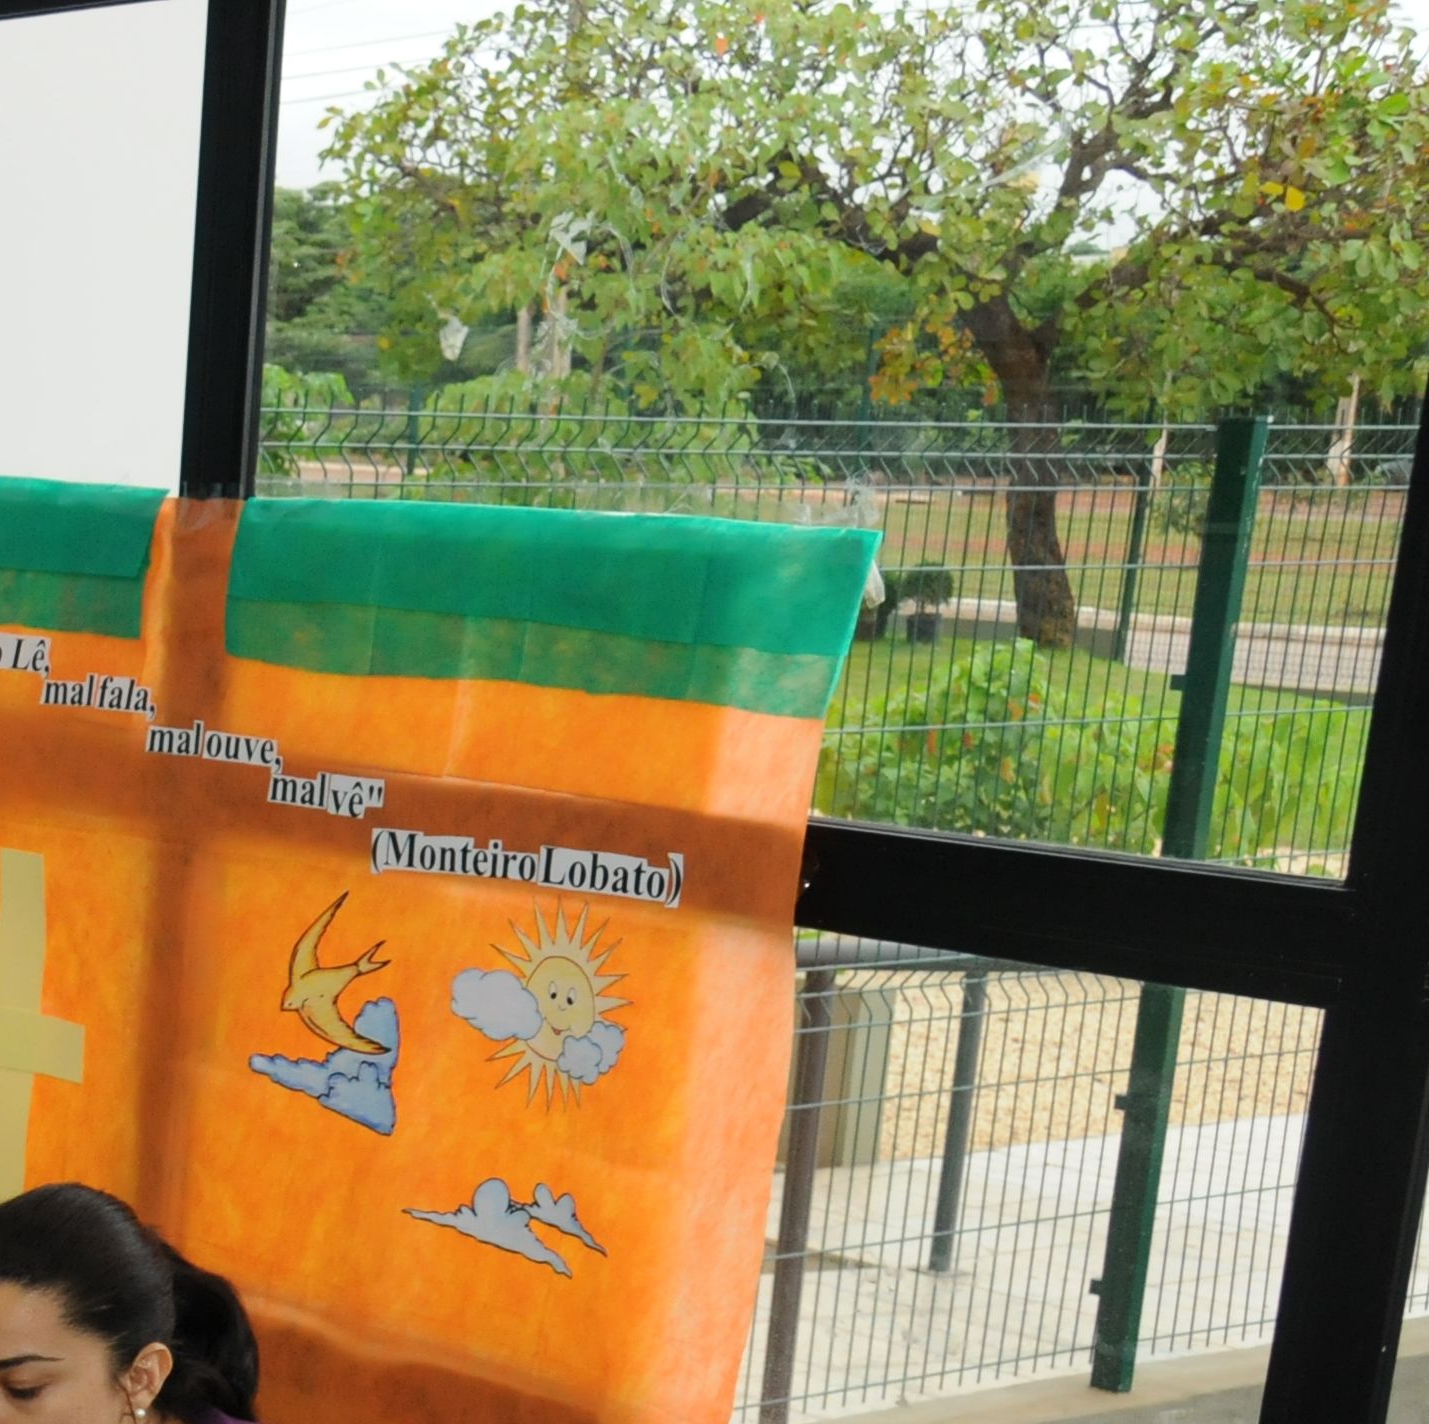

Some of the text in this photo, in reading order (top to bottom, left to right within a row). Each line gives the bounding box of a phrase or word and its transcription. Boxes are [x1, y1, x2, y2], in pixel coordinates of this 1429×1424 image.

[11, 638, 50, 677] Lê,
[43, 674, 156, 717] mal fala,
[148, 722, 282, 772] mal ouve,
[270, 773, 326, 808] mal
[371, 829, 682, 906] (Monteiro Lobato)
